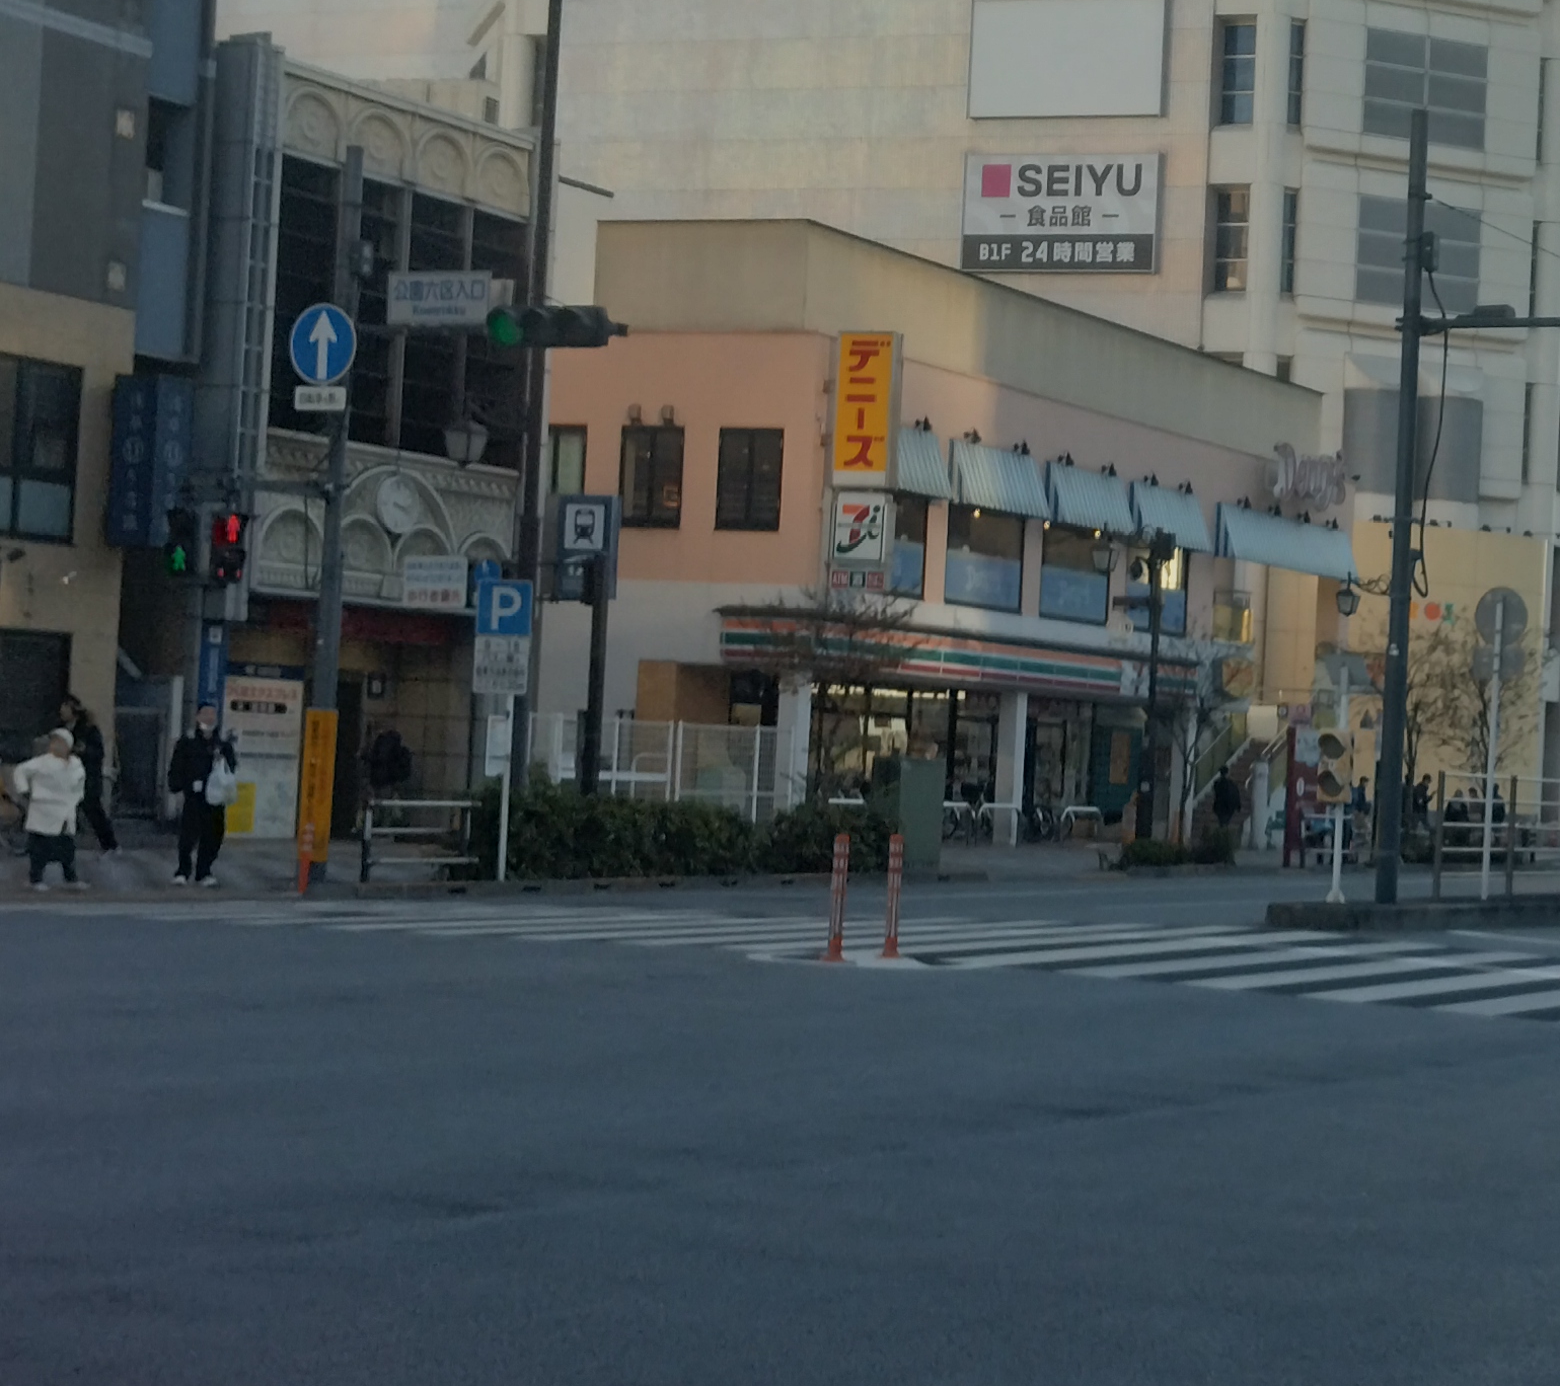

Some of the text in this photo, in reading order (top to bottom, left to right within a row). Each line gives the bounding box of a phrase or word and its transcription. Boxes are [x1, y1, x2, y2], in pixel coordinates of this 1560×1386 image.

[1016, 163, 1143, 198] SEIYU
[1026, 204, 1092, 228] 食品館
[978, 240, 1136, 264] B1F 24時間営業
[843, 339, 892, 468] デニーズ
[490, 585, 522, 631] P
